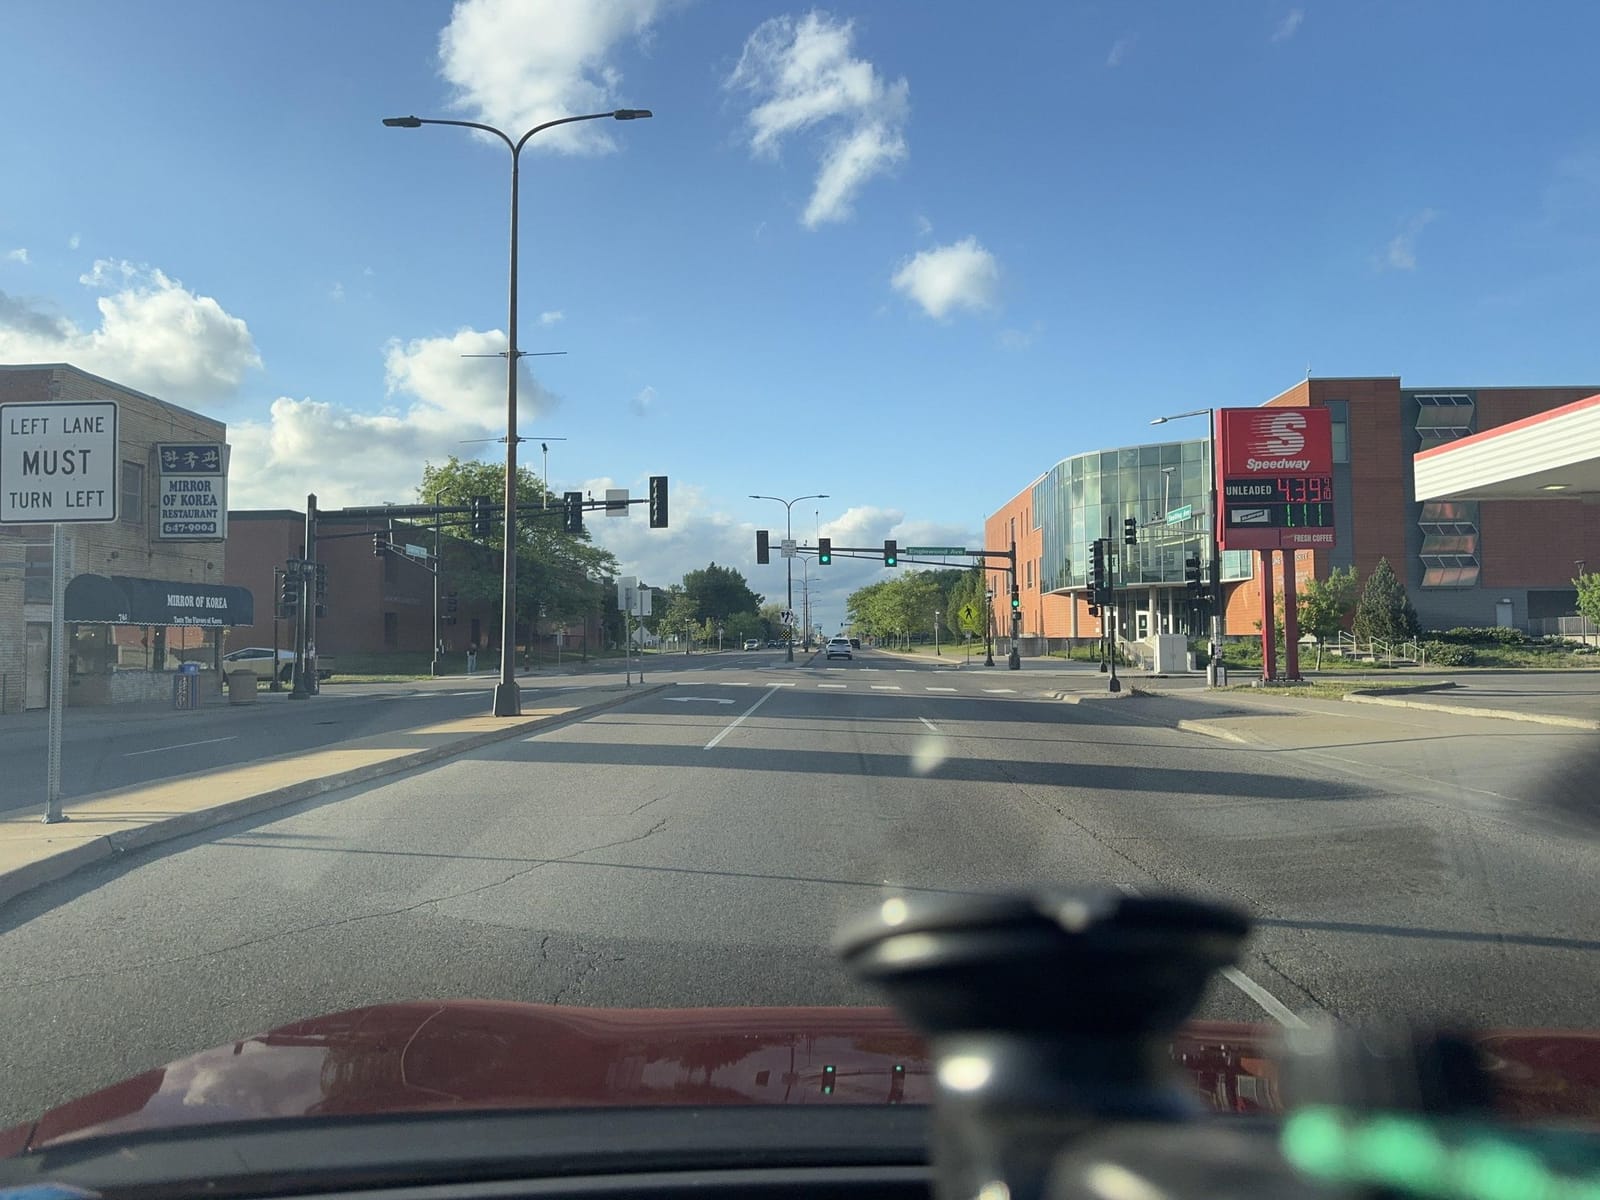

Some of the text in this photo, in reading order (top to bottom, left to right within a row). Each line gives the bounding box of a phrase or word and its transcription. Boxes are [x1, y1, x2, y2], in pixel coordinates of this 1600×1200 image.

[11, 417, 104, 435] LEFT LANE
[23, 450, 91, 476] MUST
[162, 450, 218, 469] 한국관
[1246, 458, 1310, 471] Speedway
[169, 480, 211, 492] MIRROR
[1226, 485, 1272, 496] UNLEADED
[1278, 478, 1321, 502] 4.39
[10, 491, 104, 508] TURN LEFT
[163, 494, 218, 507] OF KOREA
[162, 509, 218, 519] RESTAURANT
[1286, 503, 1322, 527] 1.11
[165, 522, 215, 533] 647-9004
[1294, 534, 1333, 542] FRESH COFFEE
[167, 594, 228, 609] MIRROR OF KOREA
